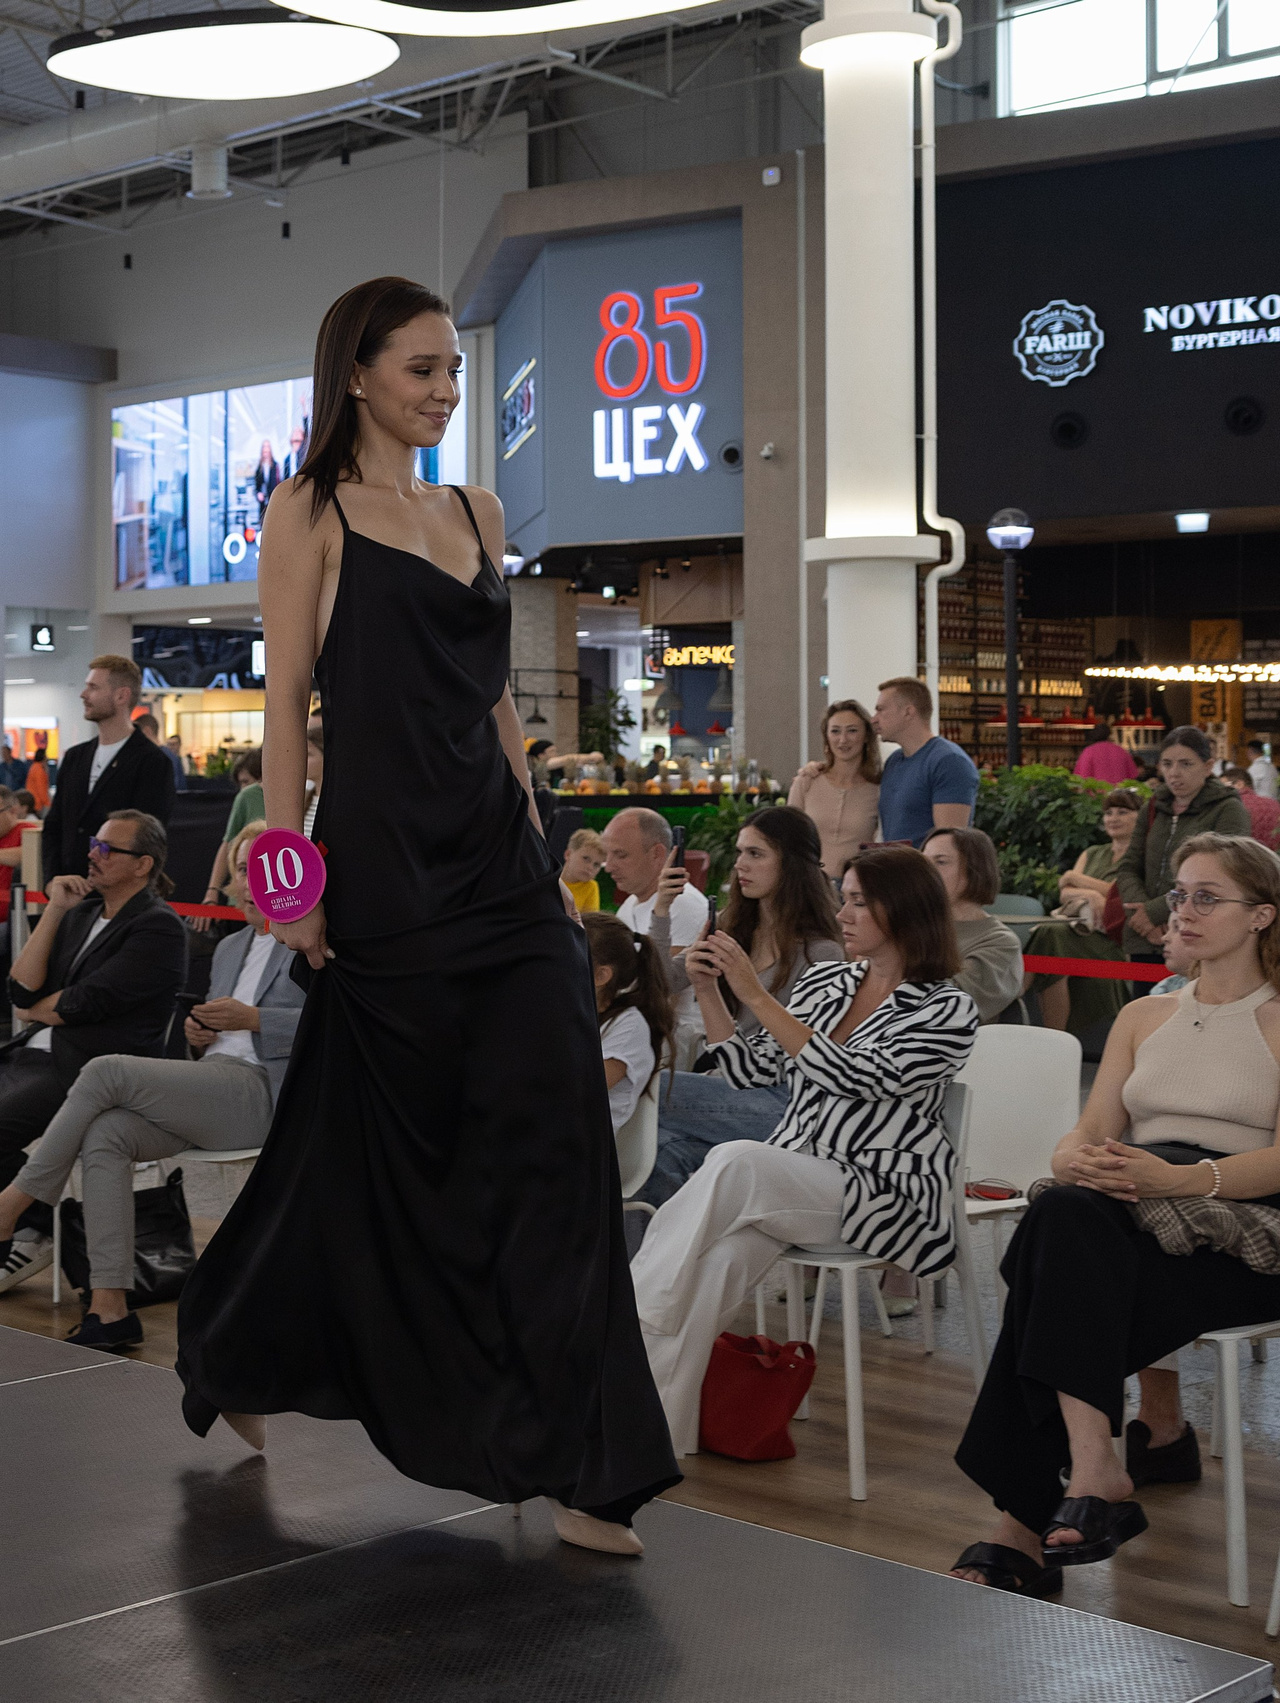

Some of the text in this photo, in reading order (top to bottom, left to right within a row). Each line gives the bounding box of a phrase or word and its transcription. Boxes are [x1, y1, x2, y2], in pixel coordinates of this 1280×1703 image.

[1143, 294, 1280, 333] NOVIKO
[594, 283, 706, 400] 85
[1024, 331, 1093, 355] FARШ
[1171, 326, 1280, 352] БУРГЕРНАЯ
[593, 403, 709, 484] ЦЕХ
[258, 847, 304, 894] 10
